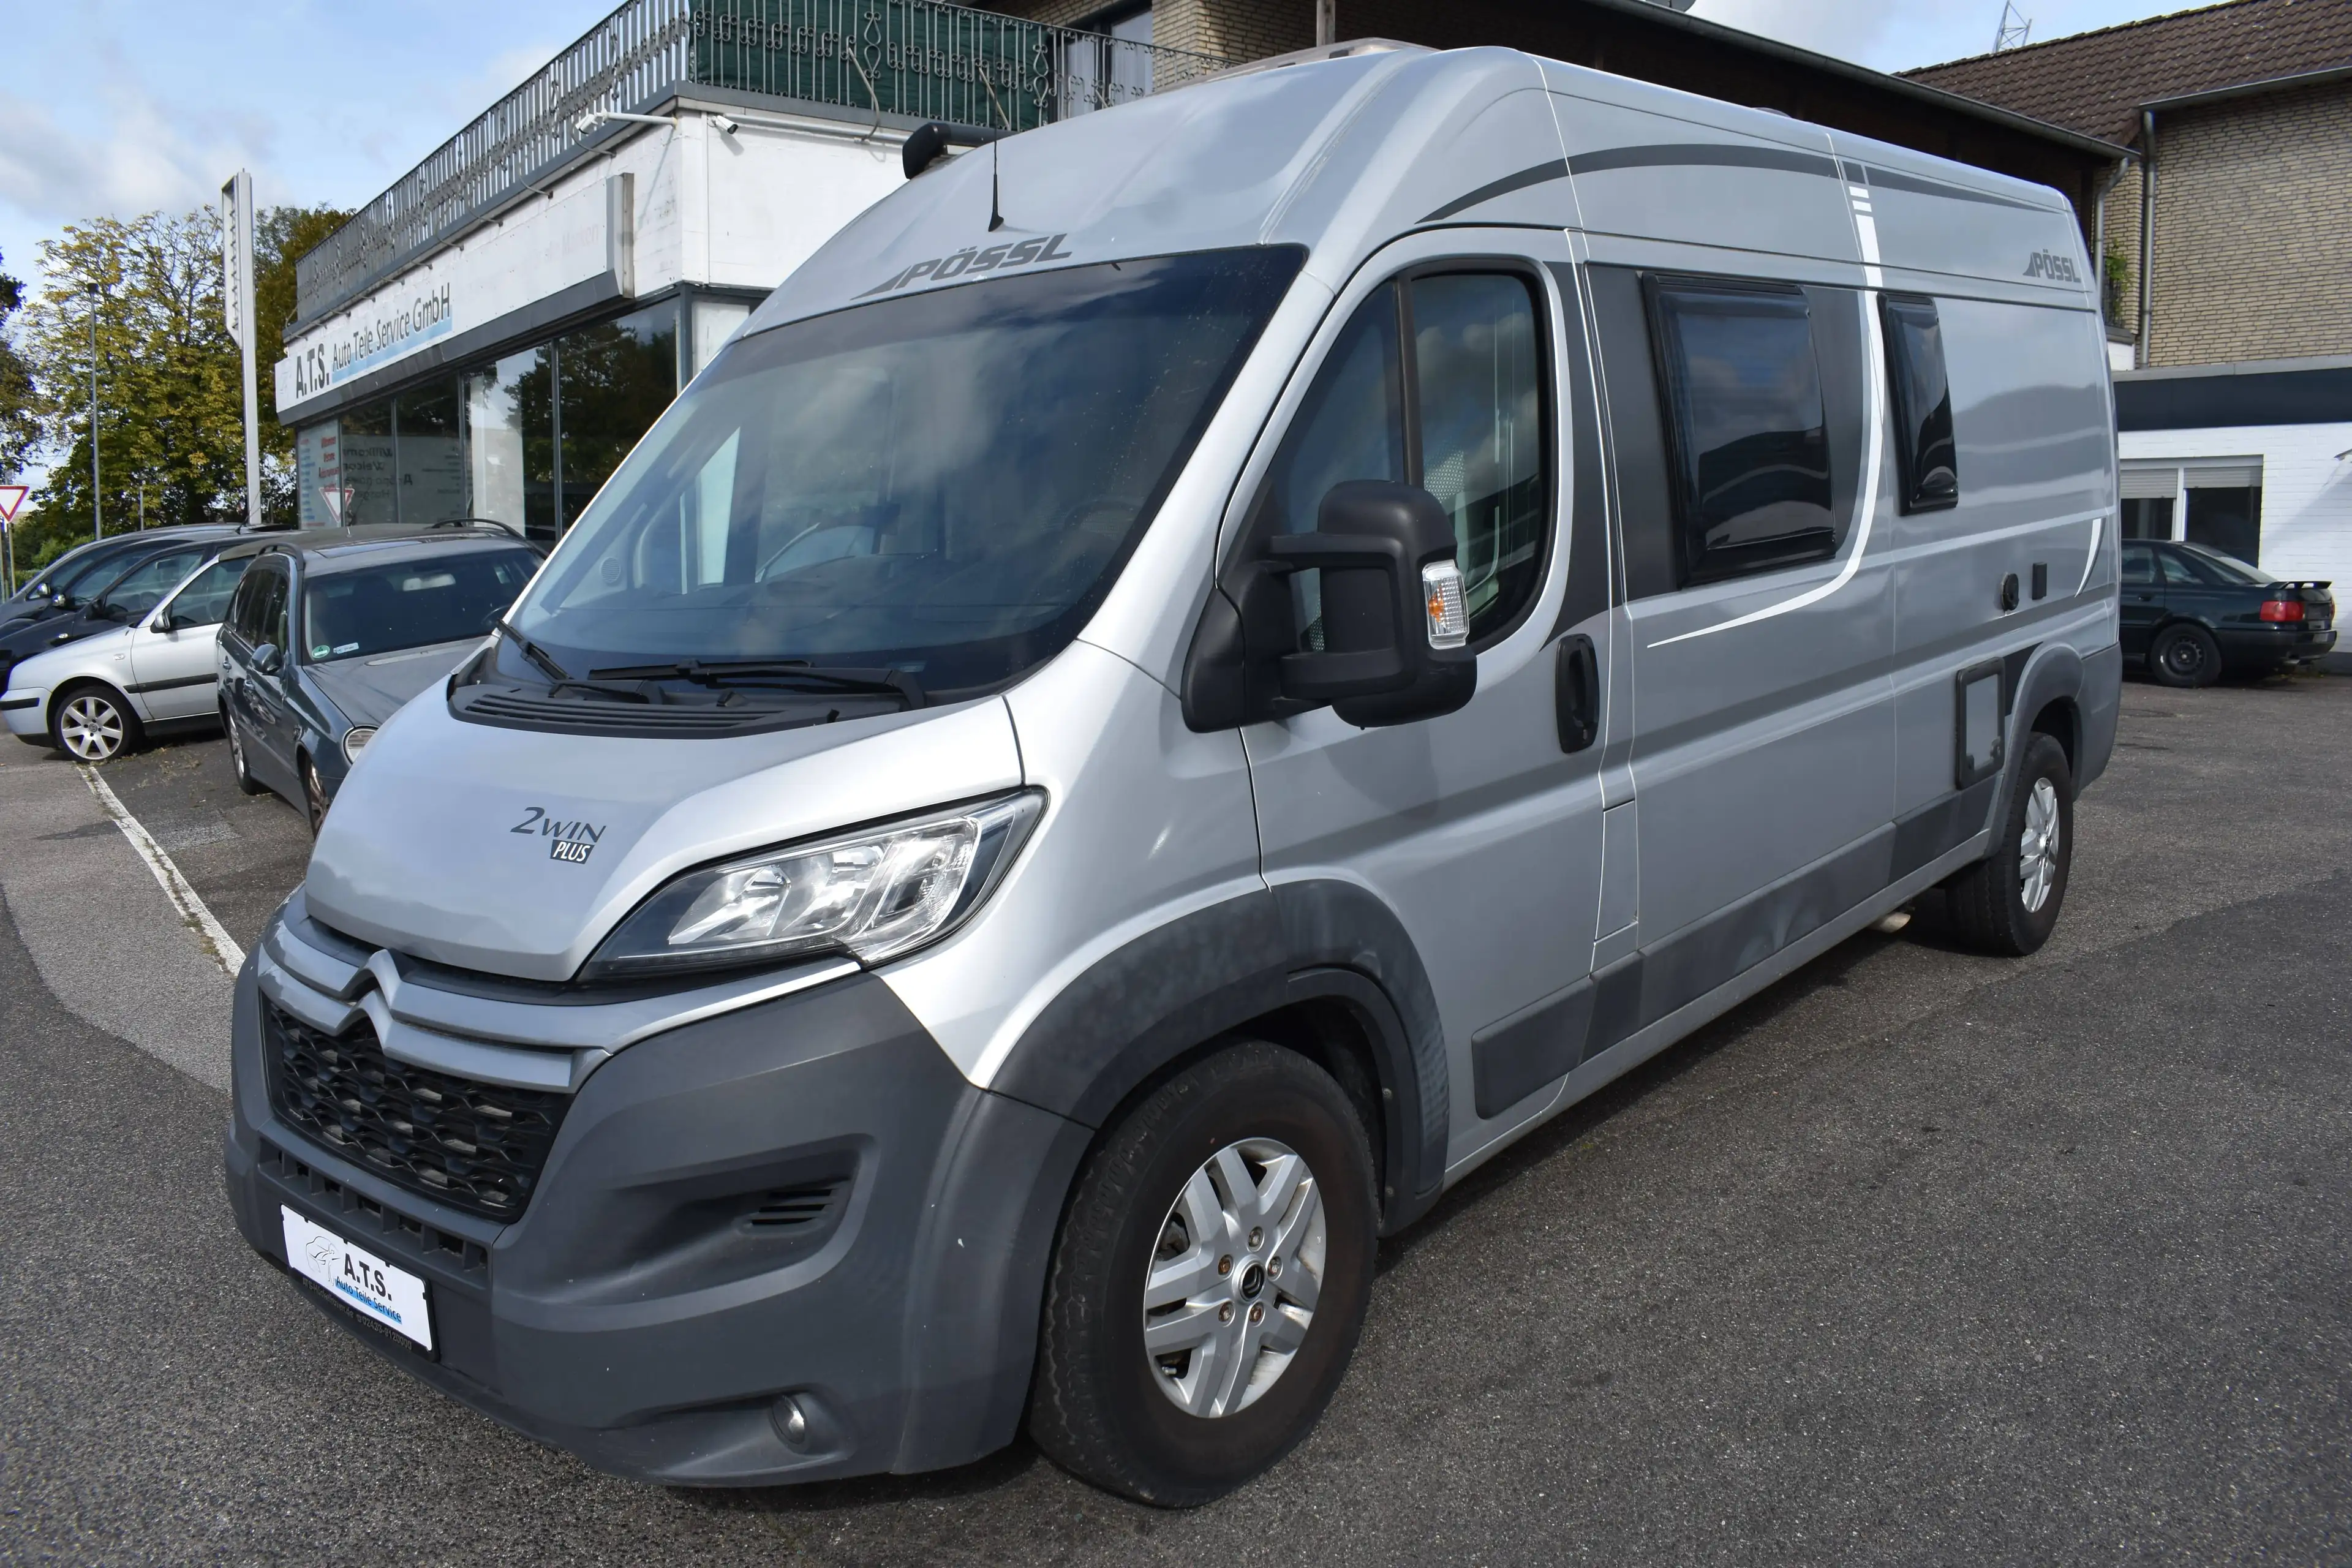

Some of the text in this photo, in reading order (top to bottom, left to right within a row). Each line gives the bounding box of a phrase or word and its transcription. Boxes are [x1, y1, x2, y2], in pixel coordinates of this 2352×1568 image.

[894, 233, 1072, 290] PÖSSL
[2032, 249, 2081, 283] PÖSSL
[296, 282, 450, 399] A.T.S. Auto Teile Service GmbH
[552, 841, 590, 862] PLUS
[336, 1276, 402, 1322] Auto Teile Service
[344, 1253, 393, 1301] A.T.S.
